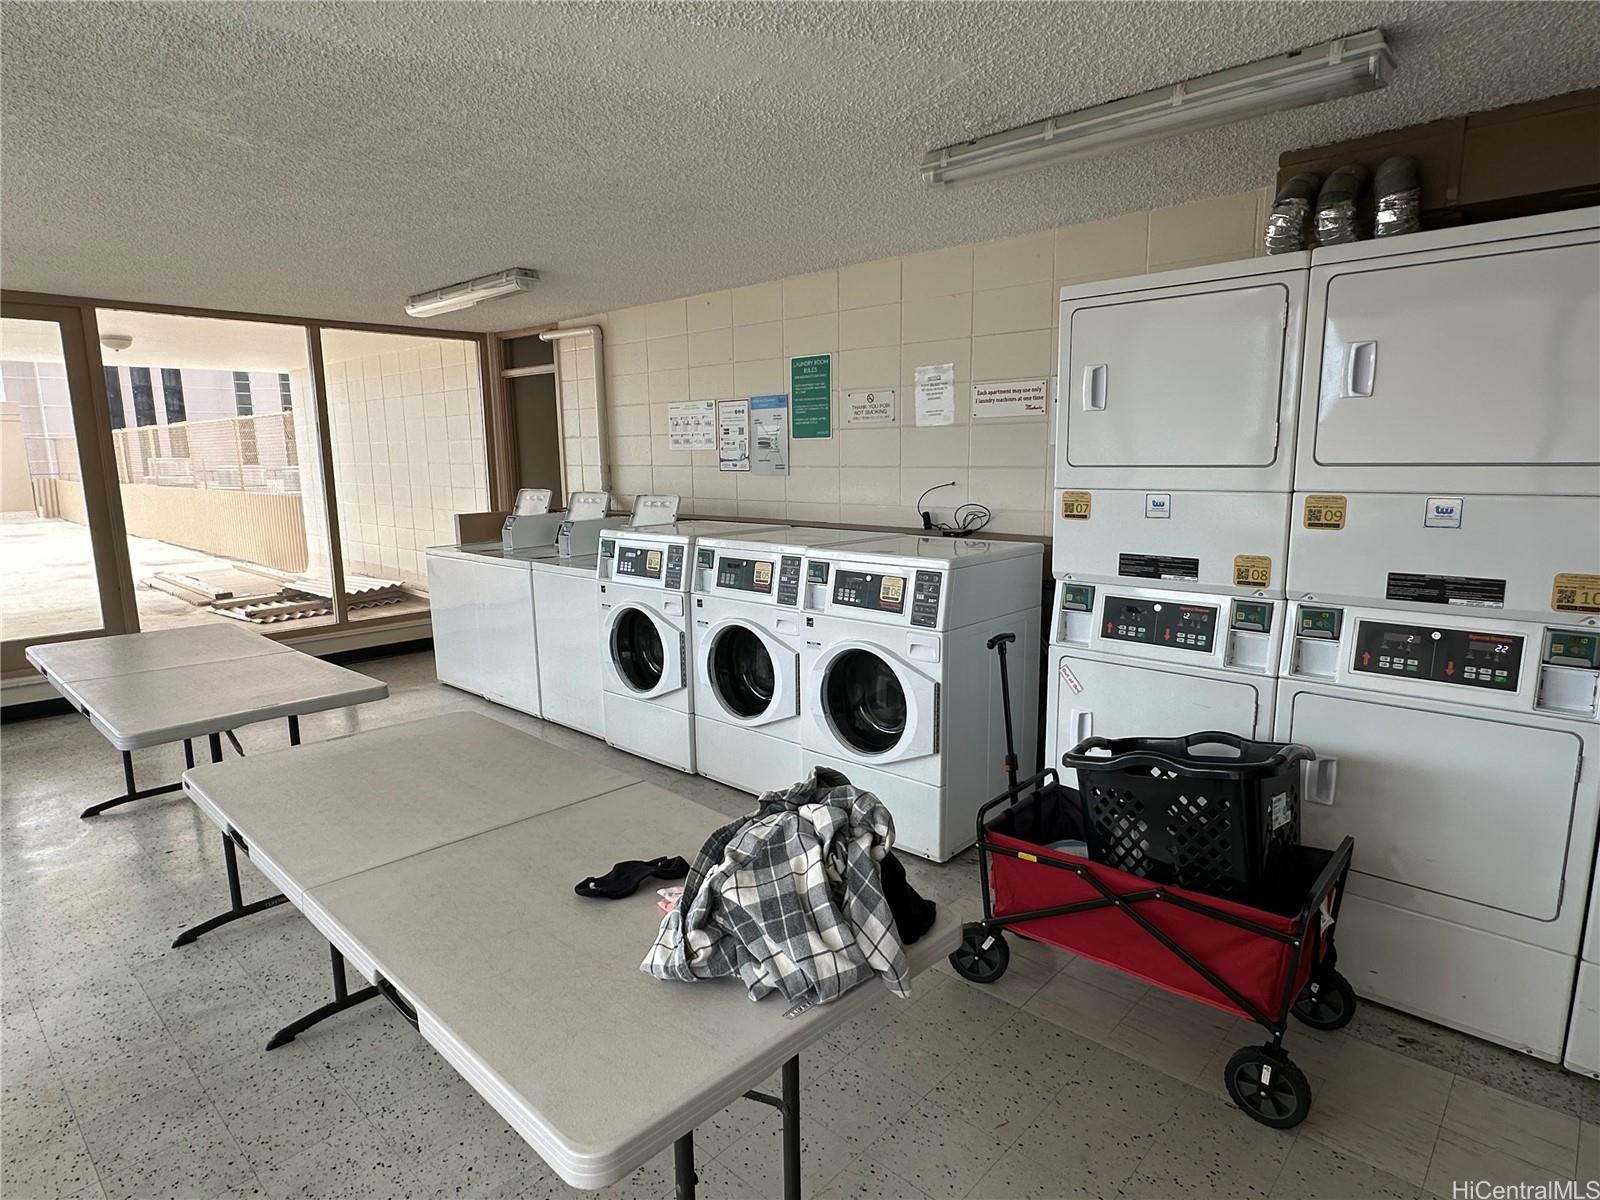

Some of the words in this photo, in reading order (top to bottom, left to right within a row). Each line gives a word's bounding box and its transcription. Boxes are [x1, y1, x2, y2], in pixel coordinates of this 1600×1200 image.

[793, 360, 813, 368] LAUNDRY
[988, 388, 1012, 396] apartment
[1075, 503, 1089, 513] 07
[1324, 510, 1343, 521] 09
[761, 571, 770, 580] 05
[1251, 569, 1268, 581] 08
[891, 587, 901, 596] 06
[1494, 644, 1509, 653] 22
